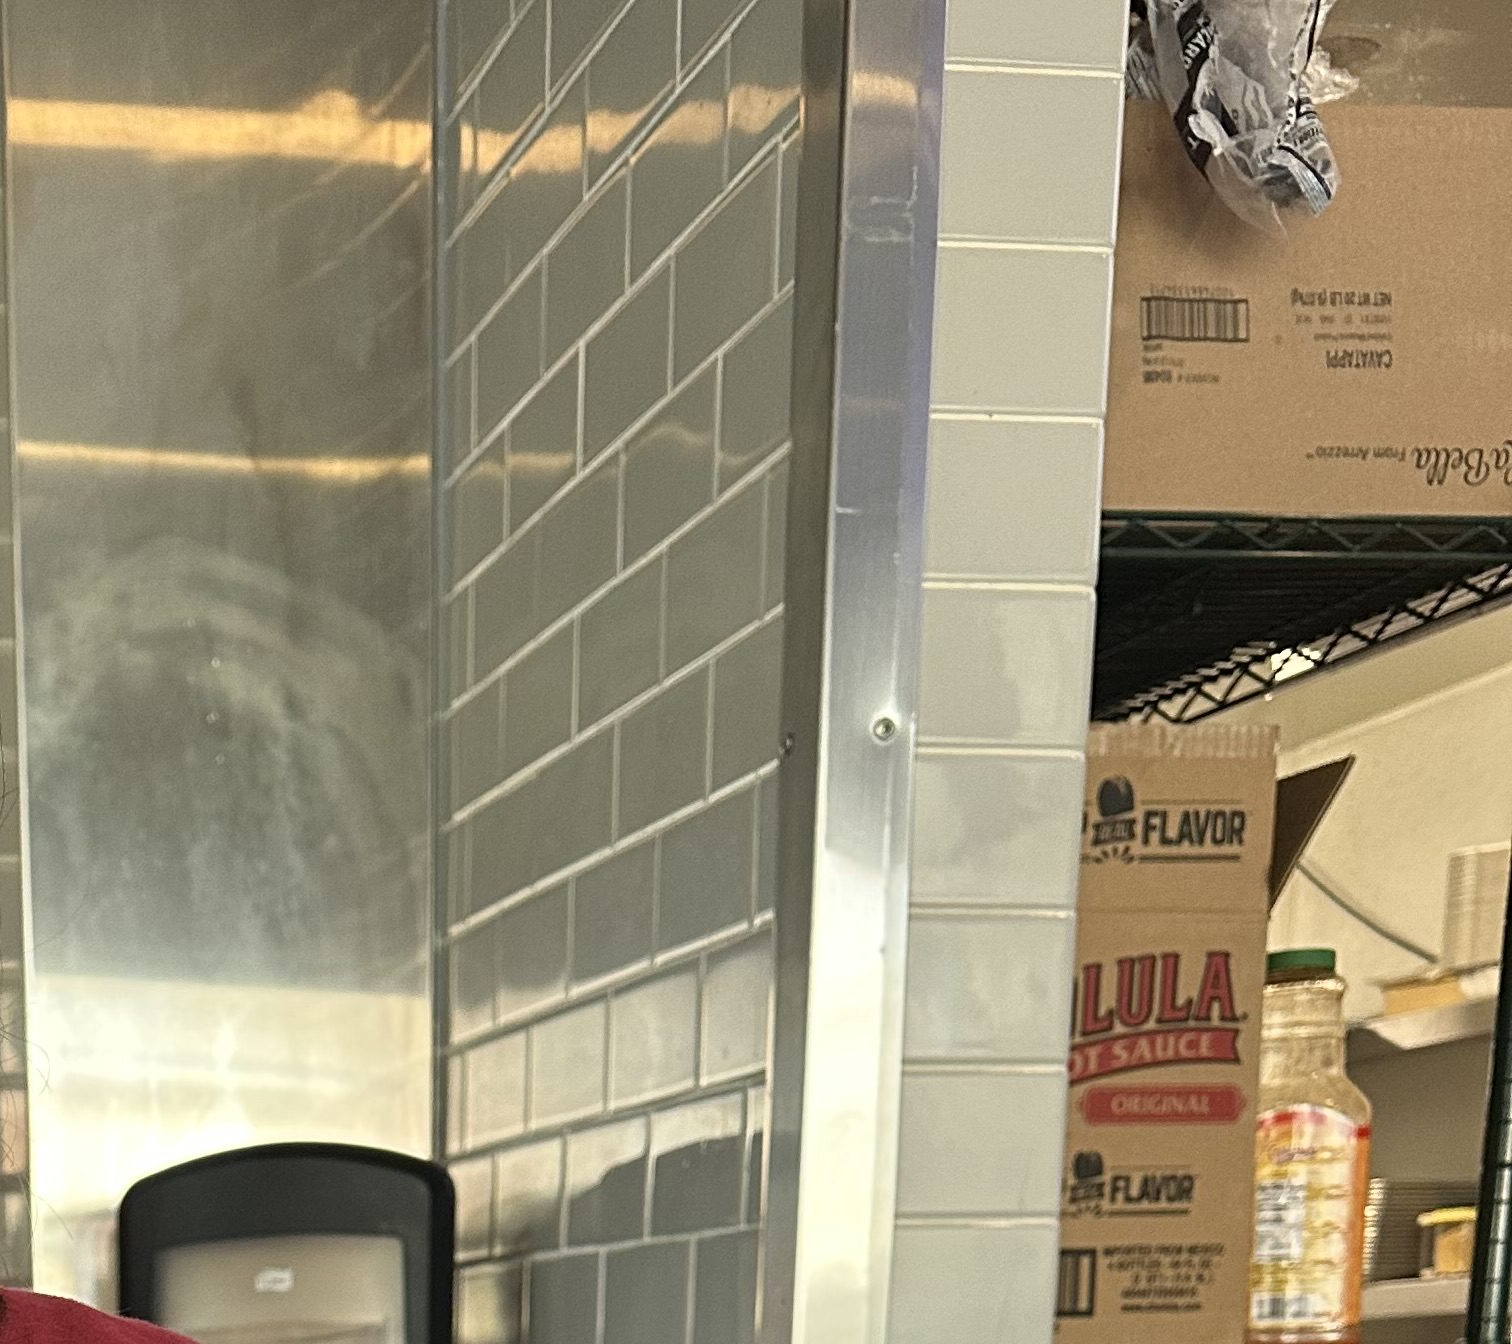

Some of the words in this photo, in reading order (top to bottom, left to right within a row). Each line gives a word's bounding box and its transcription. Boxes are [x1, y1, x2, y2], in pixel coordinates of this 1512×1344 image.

[1326, 349, 1392, 368] CAVATAPPI
[1373, 446, 1406, 462] From
[1413, 446, 1490, 487] Bella
[1141, 808, 1246, 846] FLAVOR
[1071, 951, 1238, 1037] LULA
[1067, 1044, 1104, 1081] OT
[1109, 1031, 1215, 1067] SAUCE
[1110, 1092, 1211, 1116] ORIGINAL
[1109, 1174, 1195, 1203] FLAVOR
